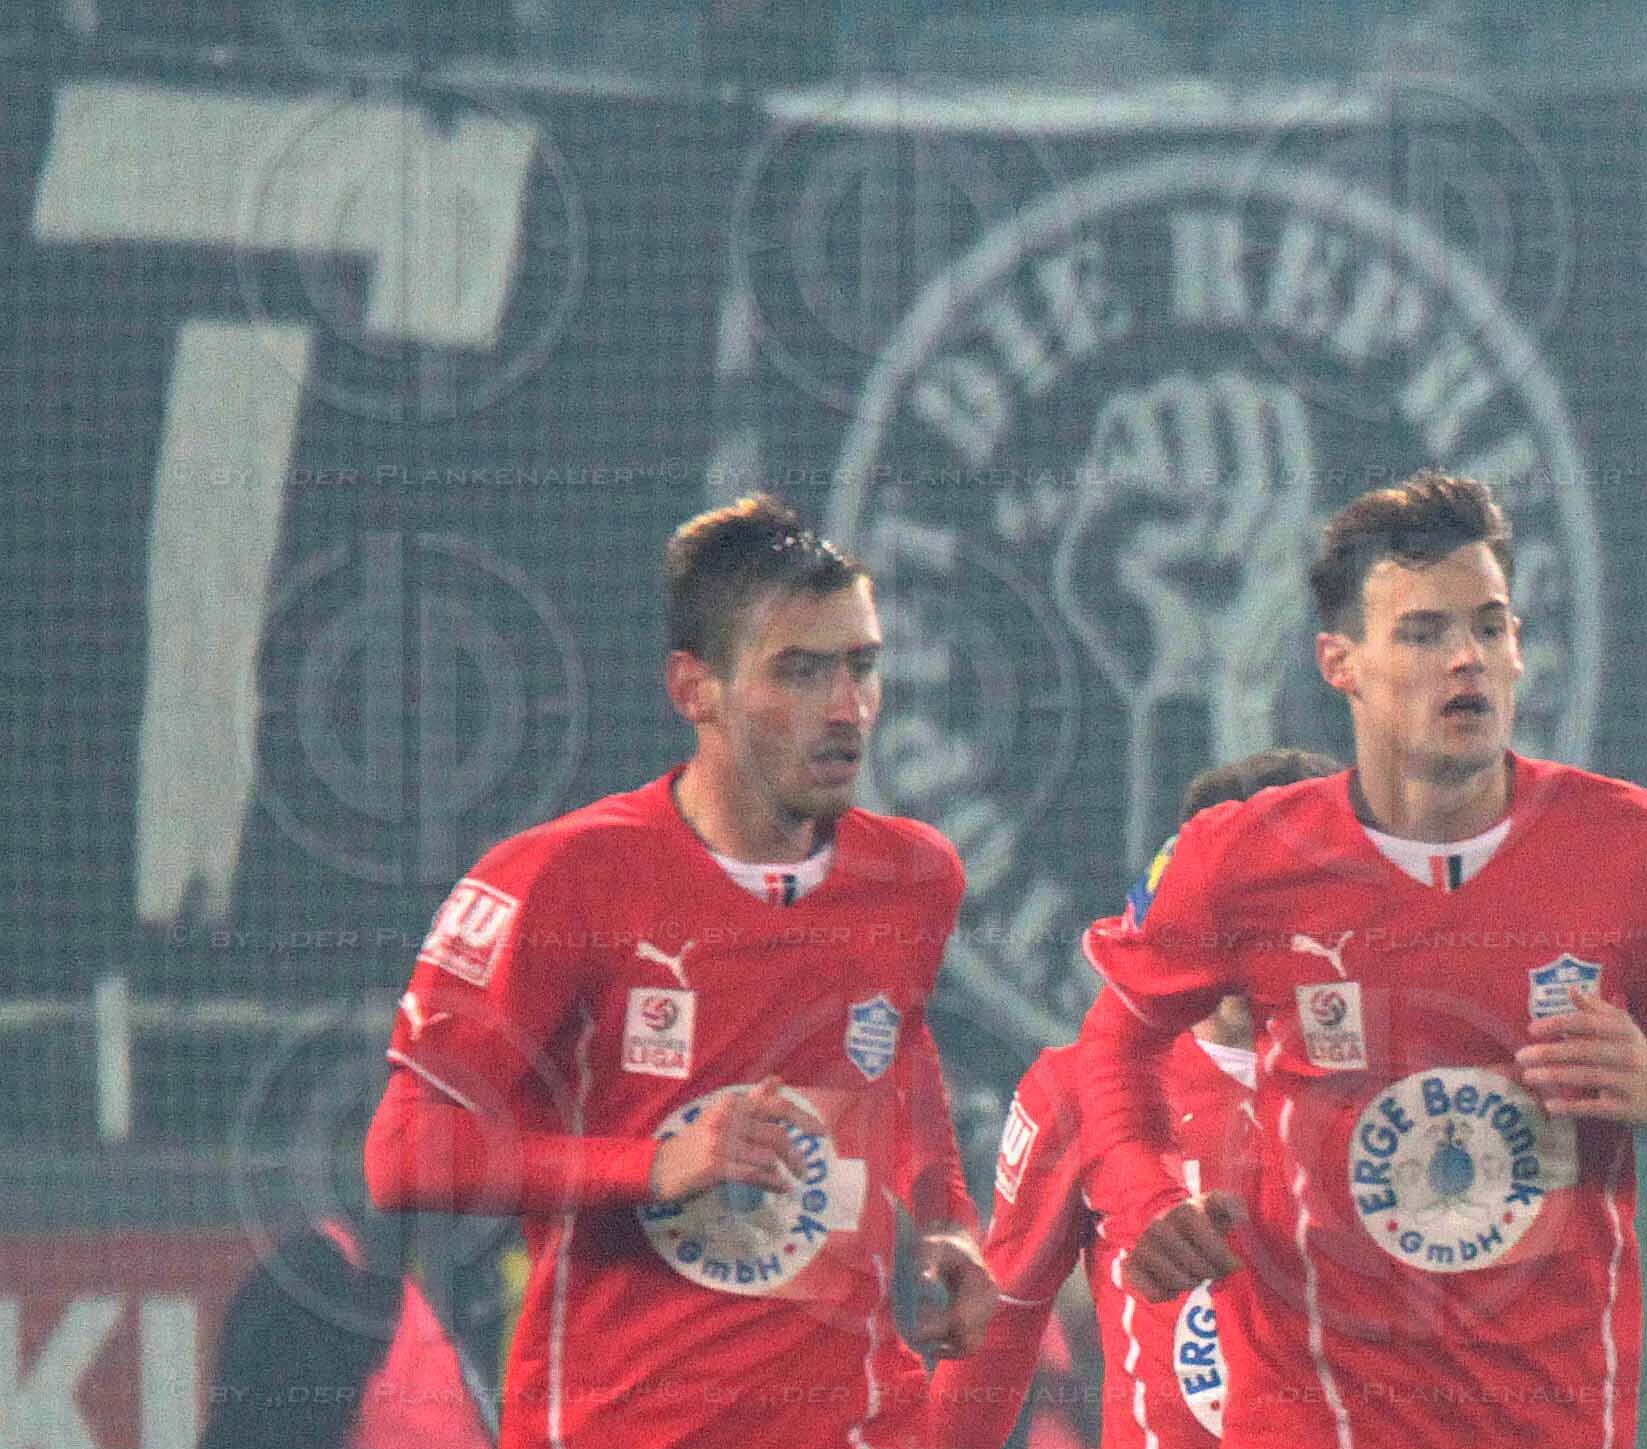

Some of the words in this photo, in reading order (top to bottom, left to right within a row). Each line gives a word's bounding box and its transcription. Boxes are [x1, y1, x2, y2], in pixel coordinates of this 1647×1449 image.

[1354, 1096, 1415, 1216] ERGE
[1399, 1223, 1504, 1264] GmbH
[1180, 1305, 1222, 1396] ERG
